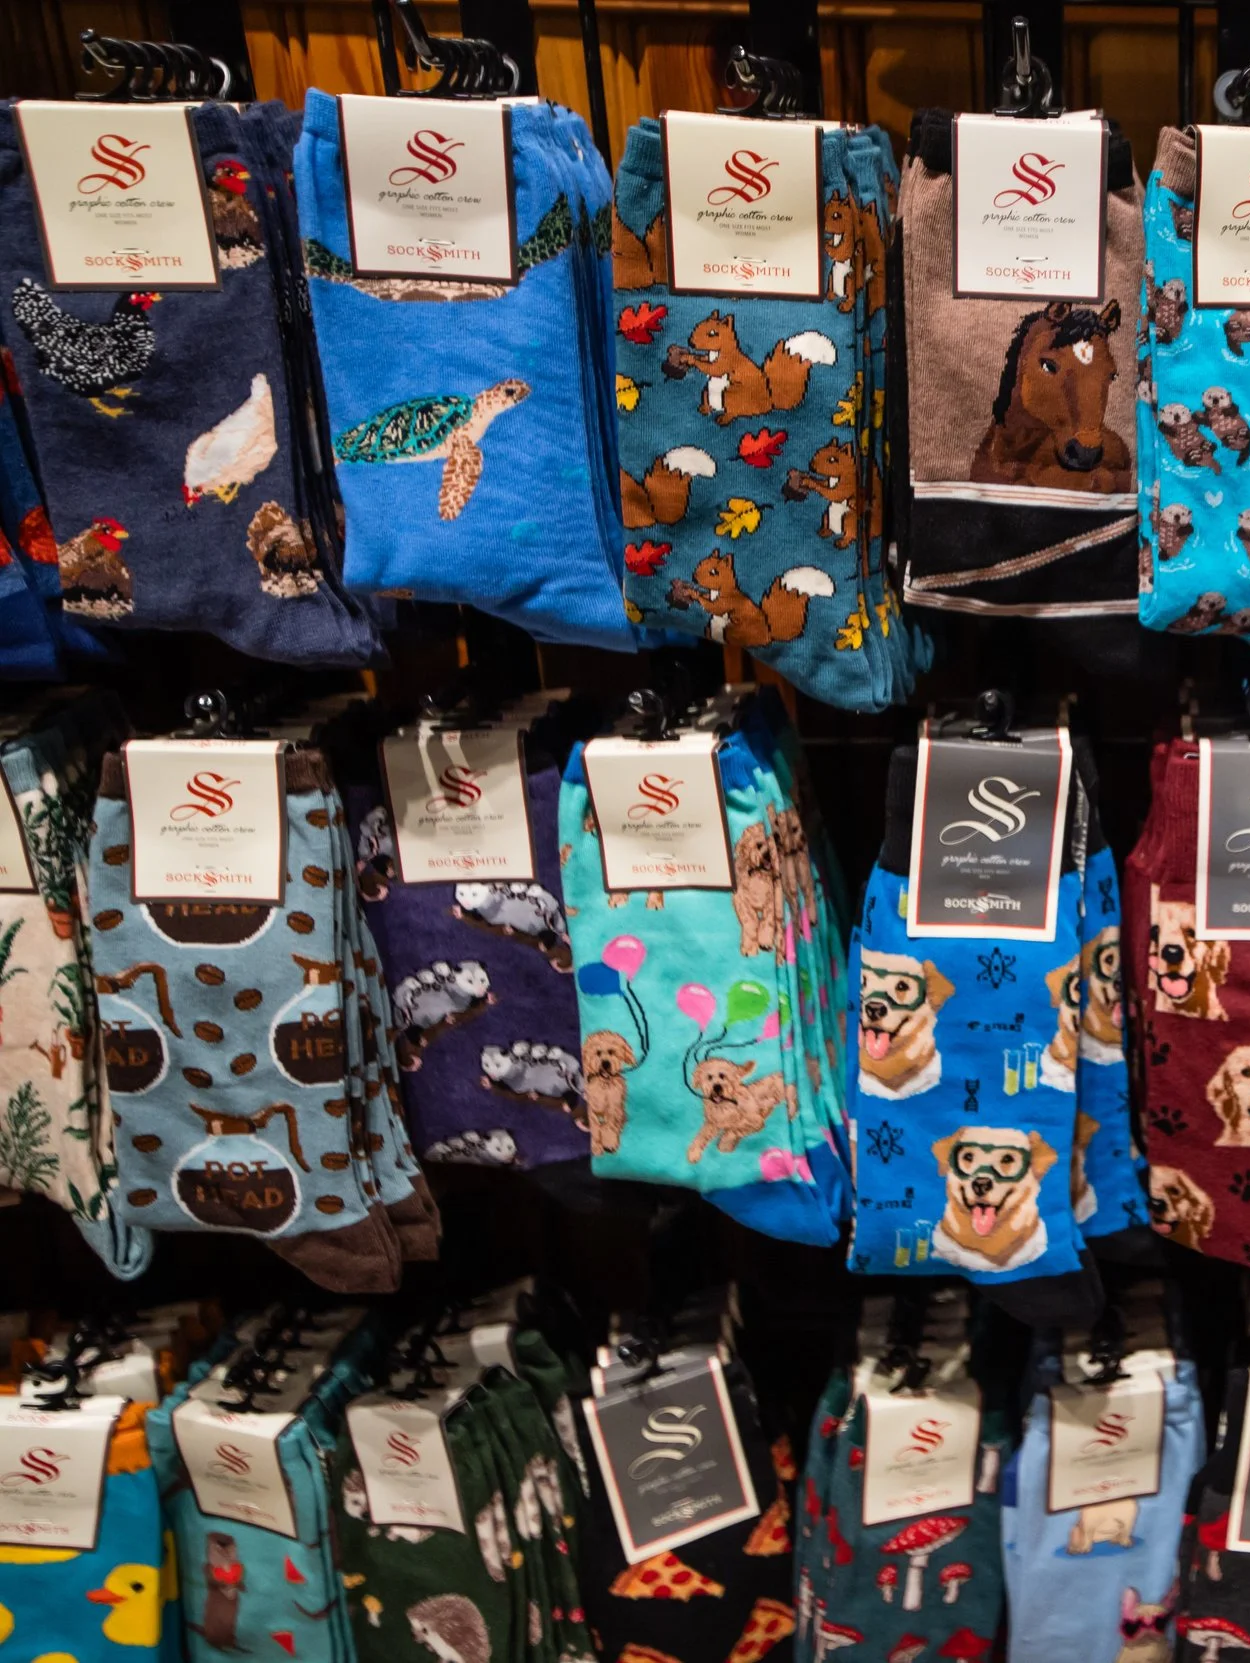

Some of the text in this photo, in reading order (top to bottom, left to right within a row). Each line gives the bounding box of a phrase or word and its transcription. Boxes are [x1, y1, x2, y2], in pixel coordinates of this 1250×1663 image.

[378, 188, 420, 202] graphic
[423, 192, 454, 202] cotton
[69, 196, 112, 212] graphic
[114, 197, 146, 207] cotton
[696, 207, 735, 222] graphic
[738, 210, 767, 221] cotton
[982, 209, 1021, 225] graphic
[1023, 213, 1051, 223] cotton
[386, 245, 480, 261] SOCKSMITH
[703, 263, 790, 279] SOCKSMITH
[985, 267, 1071, 283] SOCKSMITH
[944, 897, 1021, 913] SOCKSMITH
[205, 1160, 268, 1181] POT
